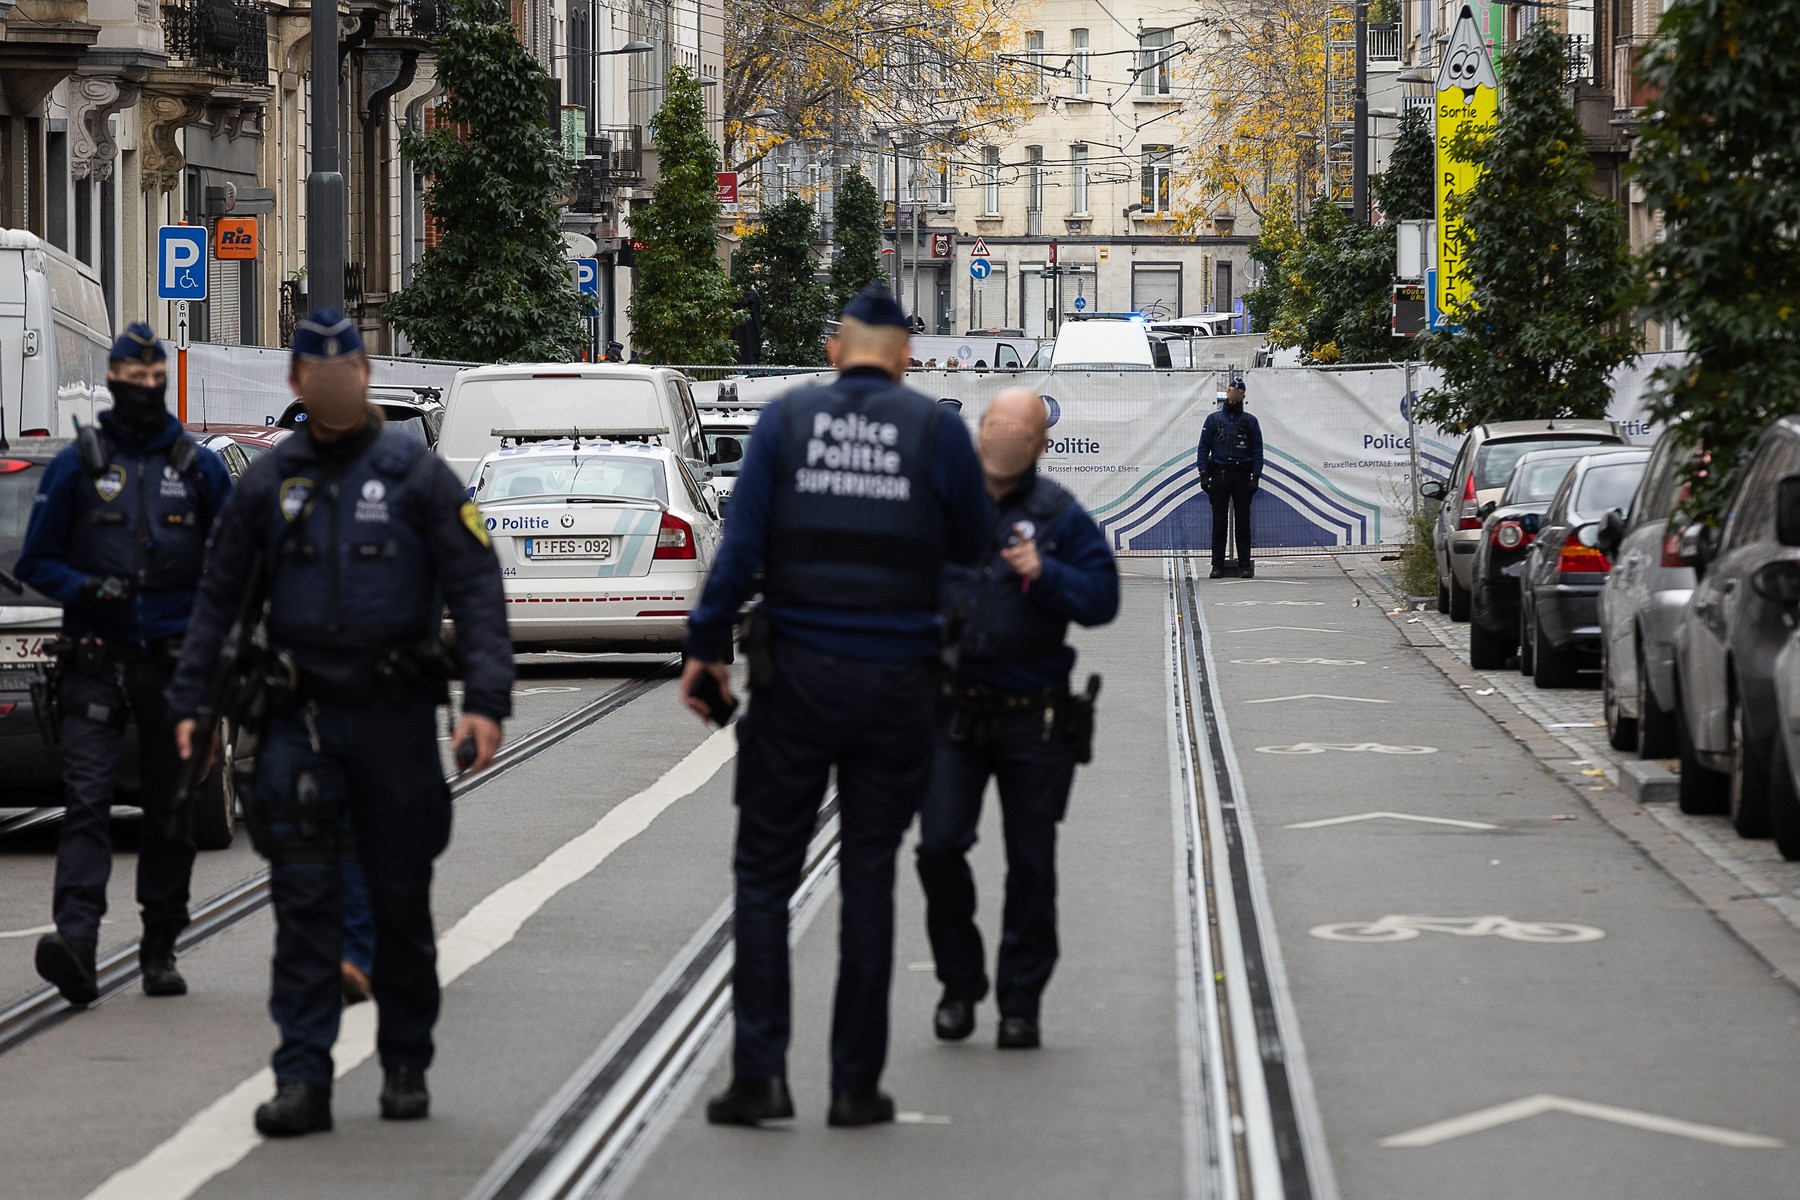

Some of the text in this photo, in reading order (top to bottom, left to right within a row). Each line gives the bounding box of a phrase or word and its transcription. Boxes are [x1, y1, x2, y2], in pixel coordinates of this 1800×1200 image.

[1440, 105, 1477, 118] Sortie
[221, 227, 252, 244] Ria
[1443, 172, 1459, 307] RAENTIR
[165, 238, 200, 288] P
[813, 411, 898, 446] Police
[1621, 419, 1651, 436] itie
[1045, 437, 1100, 454] Politie
[1363, 433, 1412, 450] Police
[807, 438, 901, 474] Politie
[1323, 461, 1357, 469] Bruxelles
[1358, 460, 1392, 468] CAPITALE
[1047, 465, 1072, 473] Brussel
[1074, 465, 1117, 473] HOOFDSTAD
[502, 516, 549, 530] Politie
